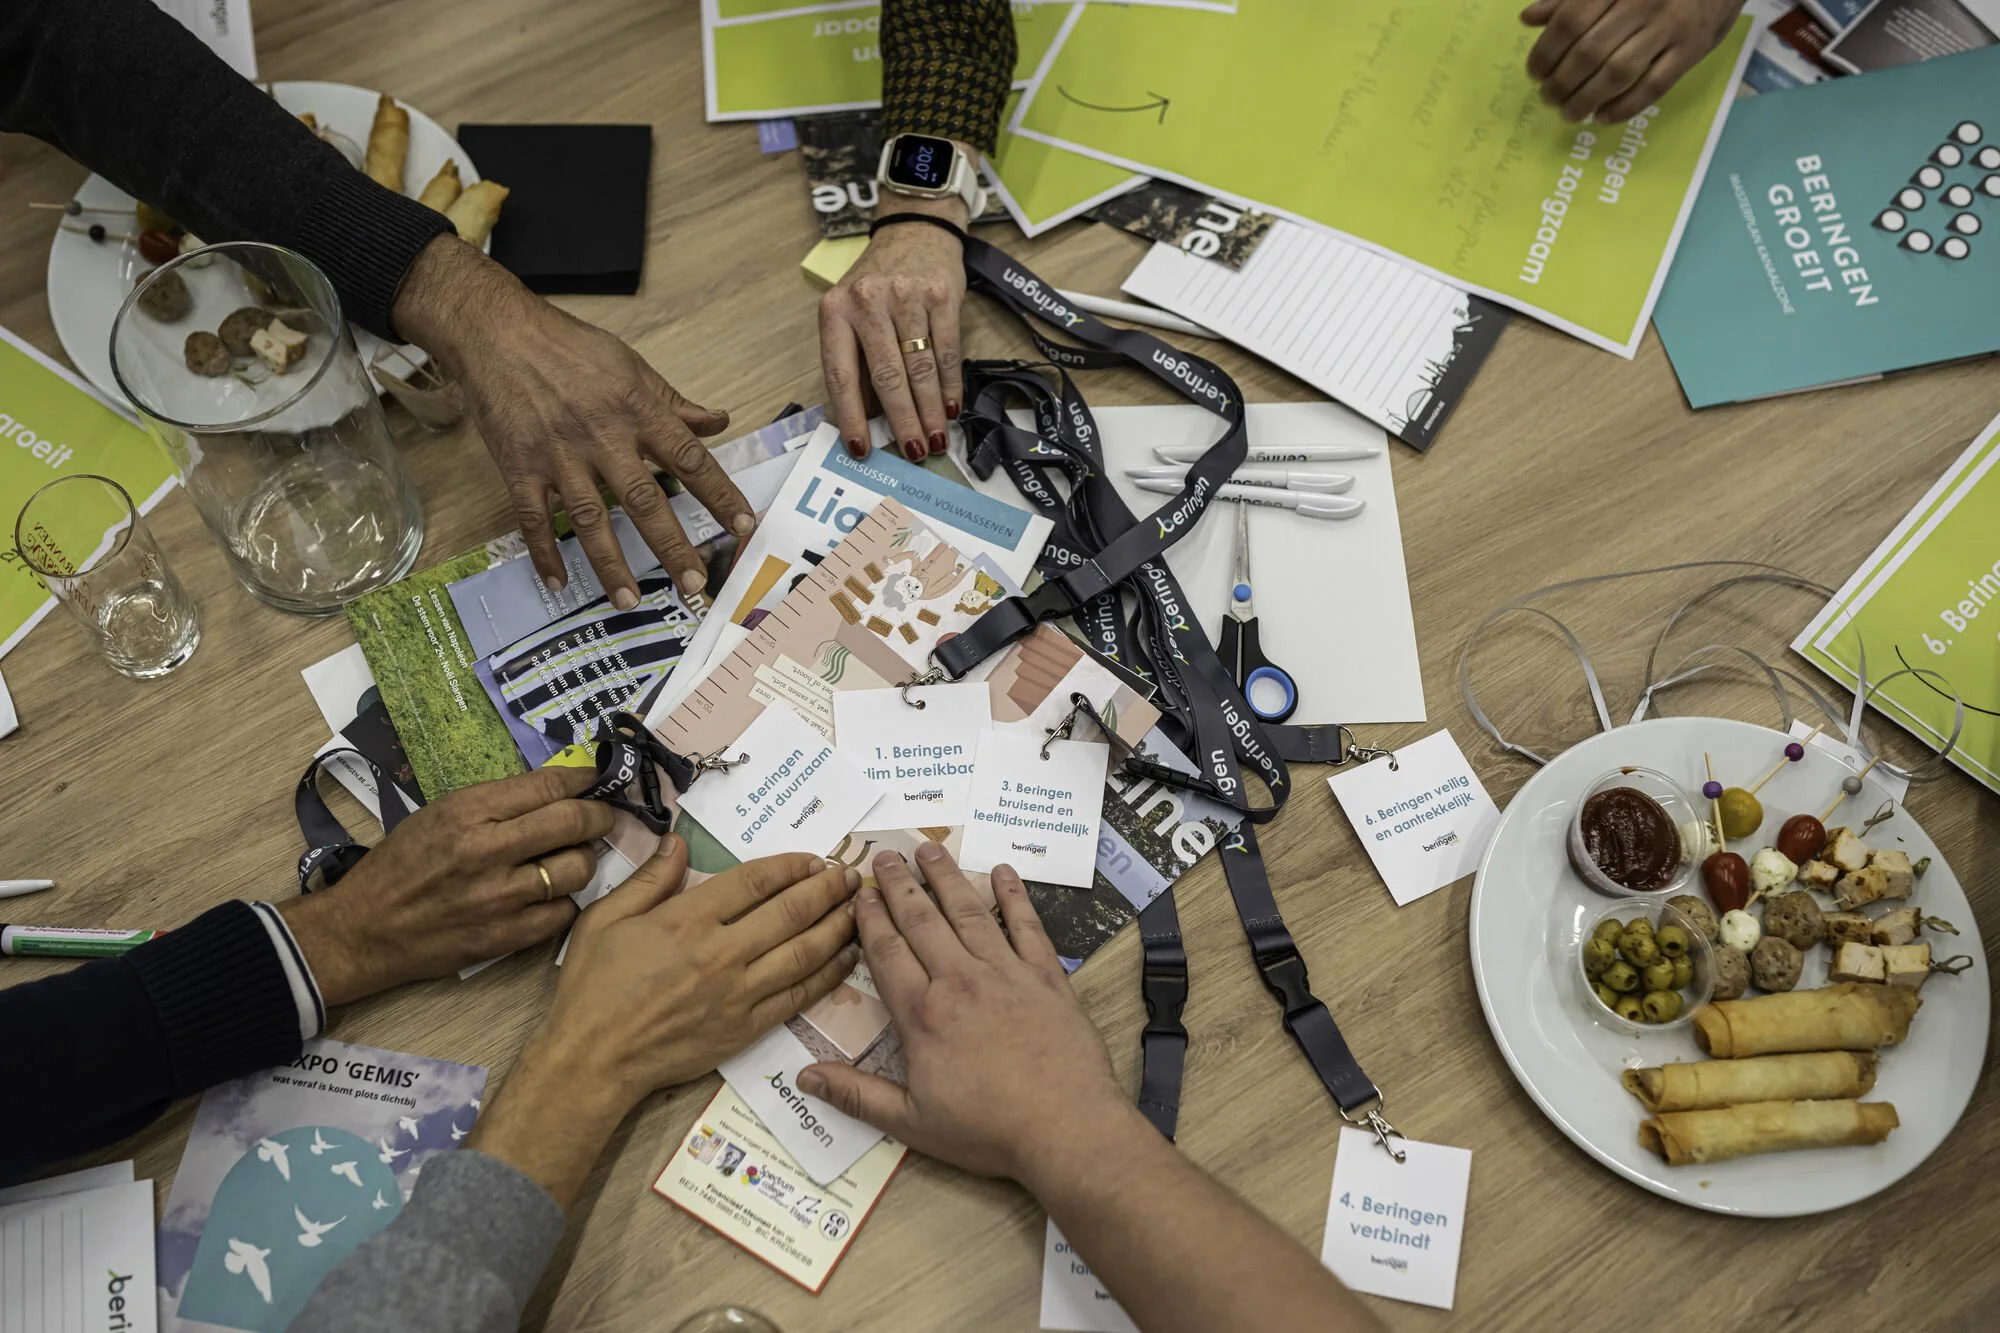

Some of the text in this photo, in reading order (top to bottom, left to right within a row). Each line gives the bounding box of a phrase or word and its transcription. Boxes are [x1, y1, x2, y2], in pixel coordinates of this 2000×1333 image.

[914, 145, 934, 181] 2007
[1519, 165, 1583, 284] zorgzaam
[1768, 183, 1833, 292] GROEIT
[1796, 154, 1879, 307] BERINGEN
[1003, 266, 1084, 328] beringen
[1152, 348, 1232, 413] beringen
[835, 452, 1015, 538] CURSUSSEN VOOR VOLWASSENEN
[1155, 475, 1211, 540] beringen
[410, 594, 423, 607] De
[414, 606, 432, 628] stem
[424, 626, 440, 646] voor
[425, 587, 471, 669] Lessen van Napoleon
[572, 632, 588, 651] naar
[1096, 592, 1121, 662] bering
[1921, 633, 1953, 655] 6.
[439, 659, 456, 680] Noël
[557, 640, 572, 658] OFP
[567, 656, 593, 691] Prolocus
[586, 690, 598, 704] op
[583, 649, 595, 663] de
[541, 647, 597, 734] Duurzaam afvalbeheer
[587, 661, 620, 706] gemeenten
[769, 674, 787, 690] ziet,
[788, 665, 813, 685] hoort.
[809, 678, 821, 690] of
[446, 678, 470, 712] Slangen
[529, 654, 597, 760] op feesten en evenementen
[786, 685, 809, 702] samen
[807, 696, 818, 707] je
[815, 703, 829, 715] wat
[754, 686, 828, 737] Praat over
[875, 743, 963, 760] 1. Beringen
[735, 804, 752, 818] 5.
[747, 747, 805, 805] Beringen
[862, 763, 974, 780] lim bereikbaa
[740, 802, 777, 845] groeit
[774, 745, 833, 810] duurzaam
[903, 790, 943, 803] beringen
[998, 797, 1073, 817] bruisend en
[1001, 780, 1073, 800] 3. Beringen
[1366, 774, 1470, 825] 6. Beringen veilig
[789, 798, 823, 830] beringen
[974, 809, 1090, 837] leeftijdsvriendelijk
[1375, 792, 1475, 841] en aantrekkelijk
[1011, 841, 1046, 856] beringen
[1422, 833, 1457, 852] beringen
[272, 1075, 418, 1109] wat veraf is komt plots dichtbij
[764, 1070, 835, 1149] beringen
[756, 1163, 798, 1196] Spectrum
[704, 1182, 745, 1211] Financieel
[741, 1206, 773, 1230] steunen
[1338, 1191, 1448, 1228] 4. Beringen
[1350, 1221, 1432, 1251] verbindt
[108, 1269, 134, 1333] beri
